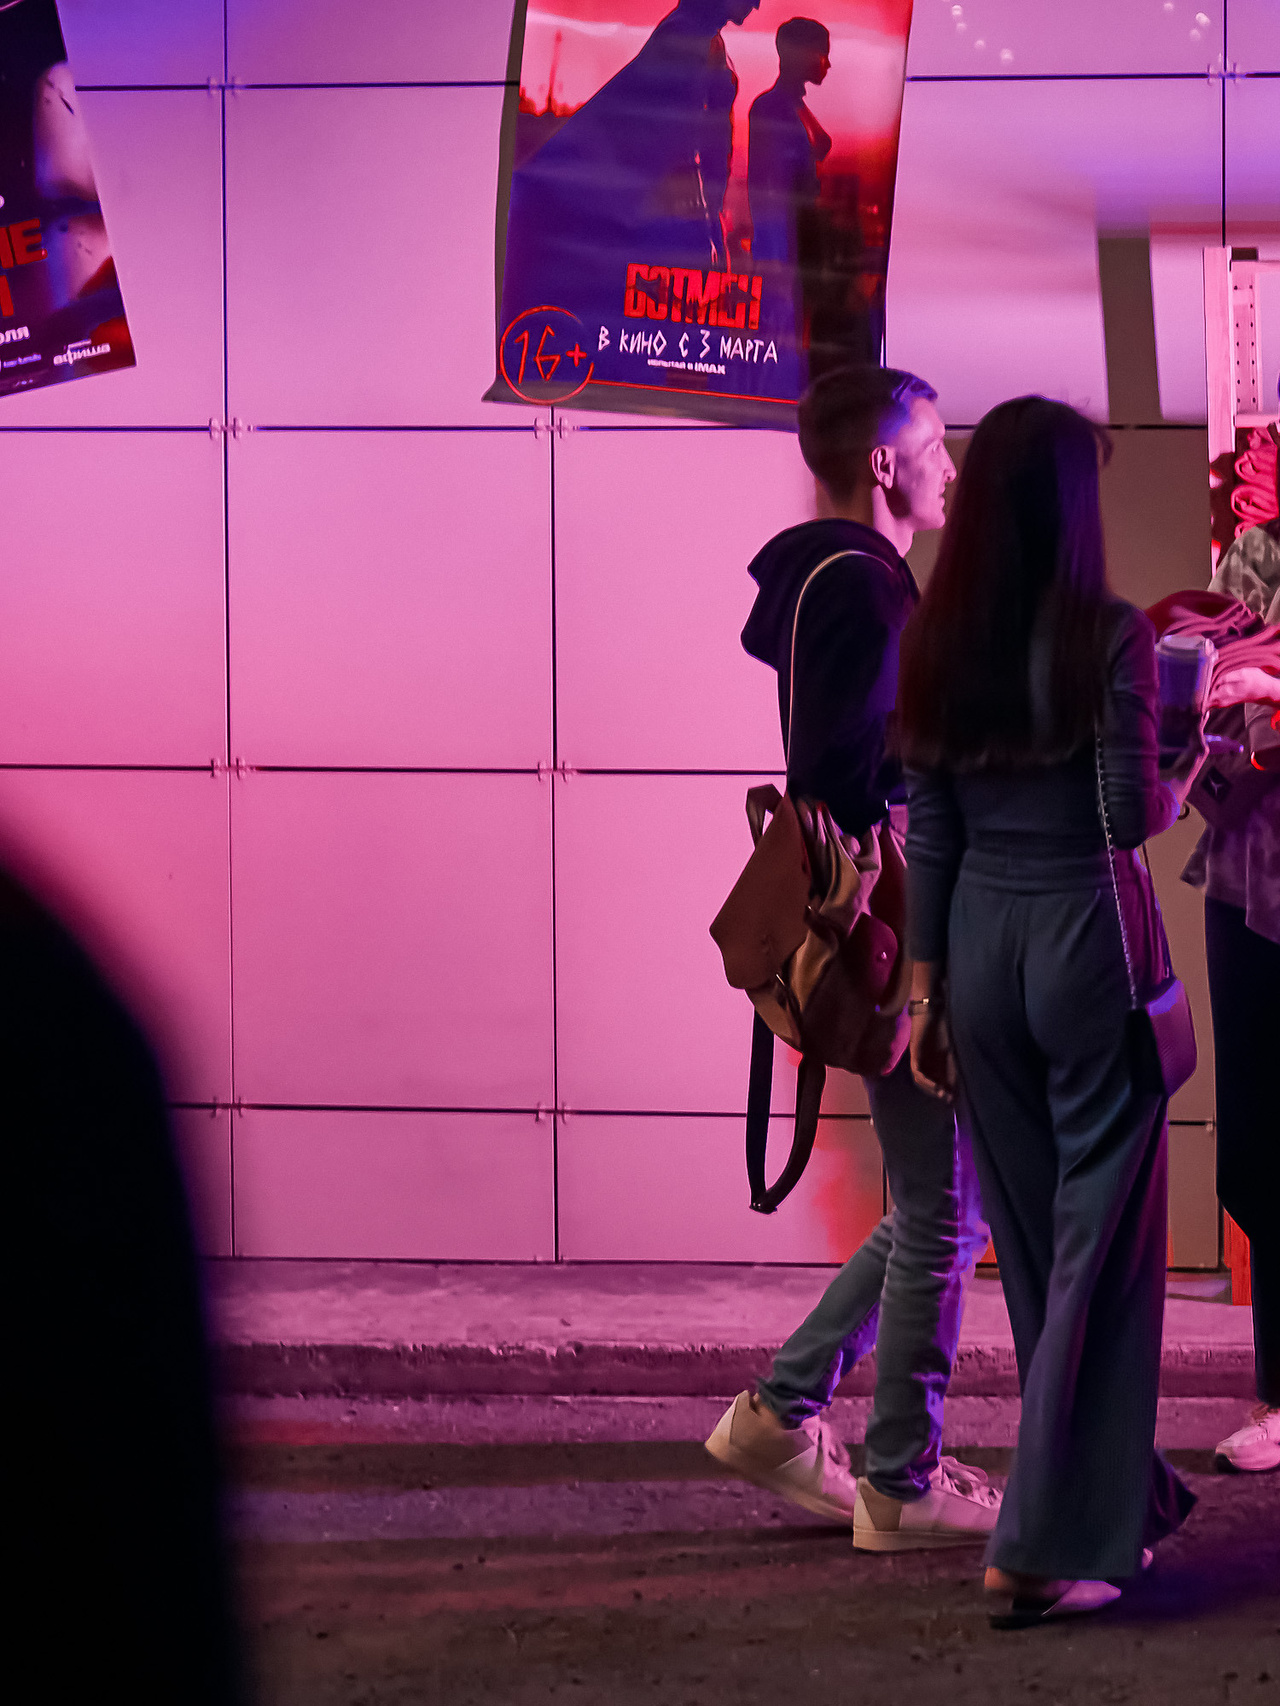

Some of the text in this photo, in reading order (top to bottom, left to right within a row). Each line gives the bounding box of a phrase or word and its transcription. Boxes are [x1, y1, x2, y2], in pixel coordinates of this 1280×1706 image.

[514, 324, 588, 384] 16+
[598, 325, 611, 351] В
[619, 328, 667, 357] КИНО
[699, 329, 711, 359] 3
[719, 335, 778, 364] МАРТА
[694, 362, 726, 375] IMAX
